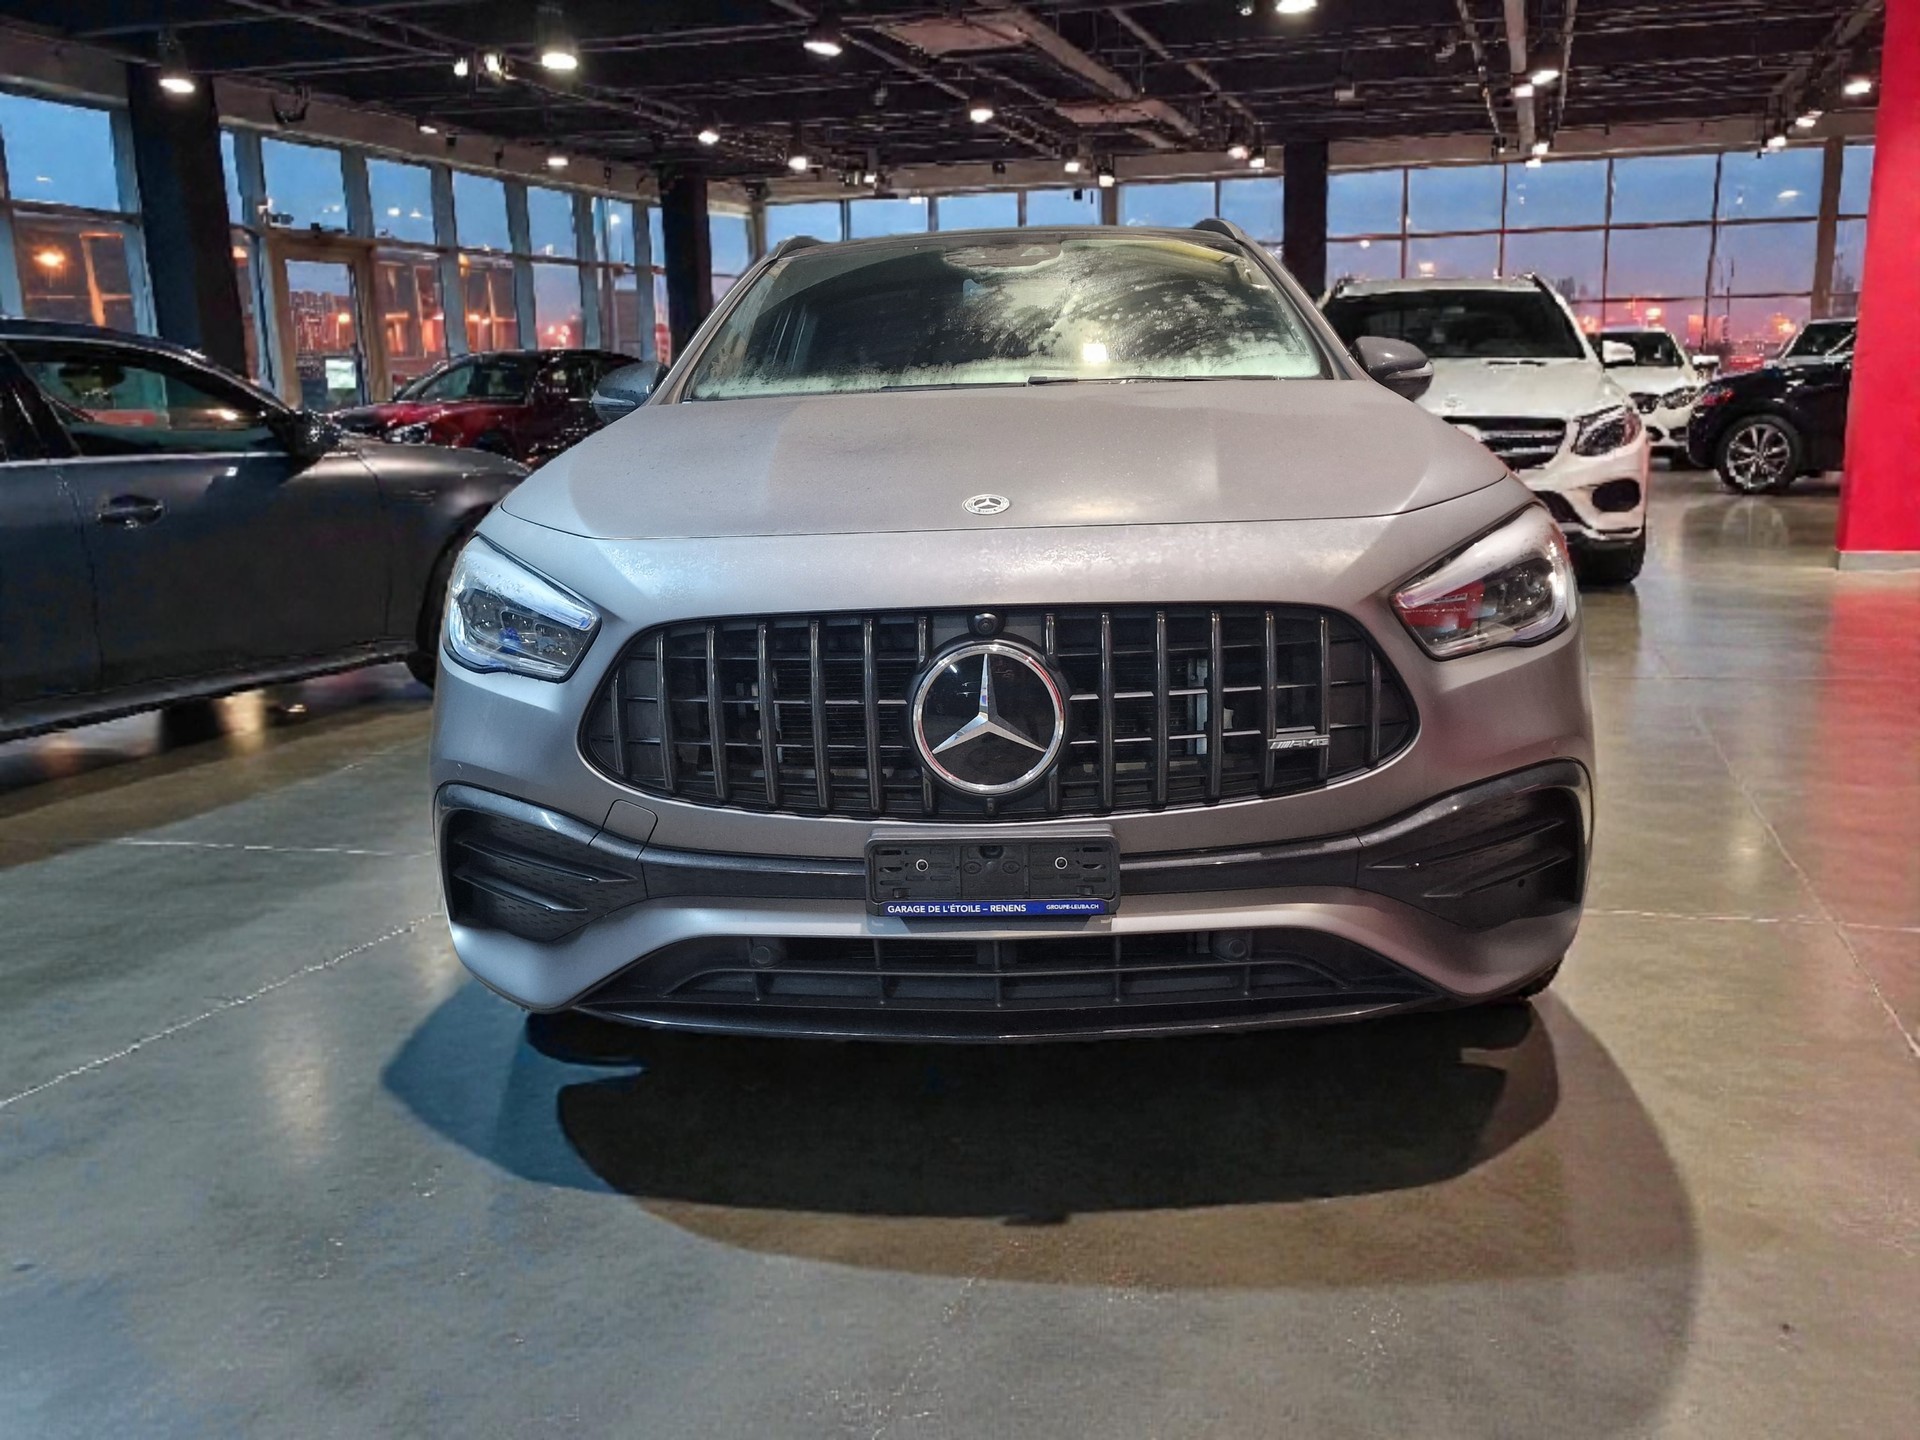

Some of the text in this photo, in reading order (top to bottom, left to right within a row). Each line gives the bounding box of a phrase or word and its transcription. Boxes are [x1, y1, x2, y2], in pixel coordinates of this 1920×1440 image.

[1289, 738, 1329, 748] AMG
[887, 905, 926, 913] GARAGE
[927, 905, 941, 913] DE
[942, 903, 981, 913] L'ÉTOILE
[990, 904, 1027, 912] RENENS
